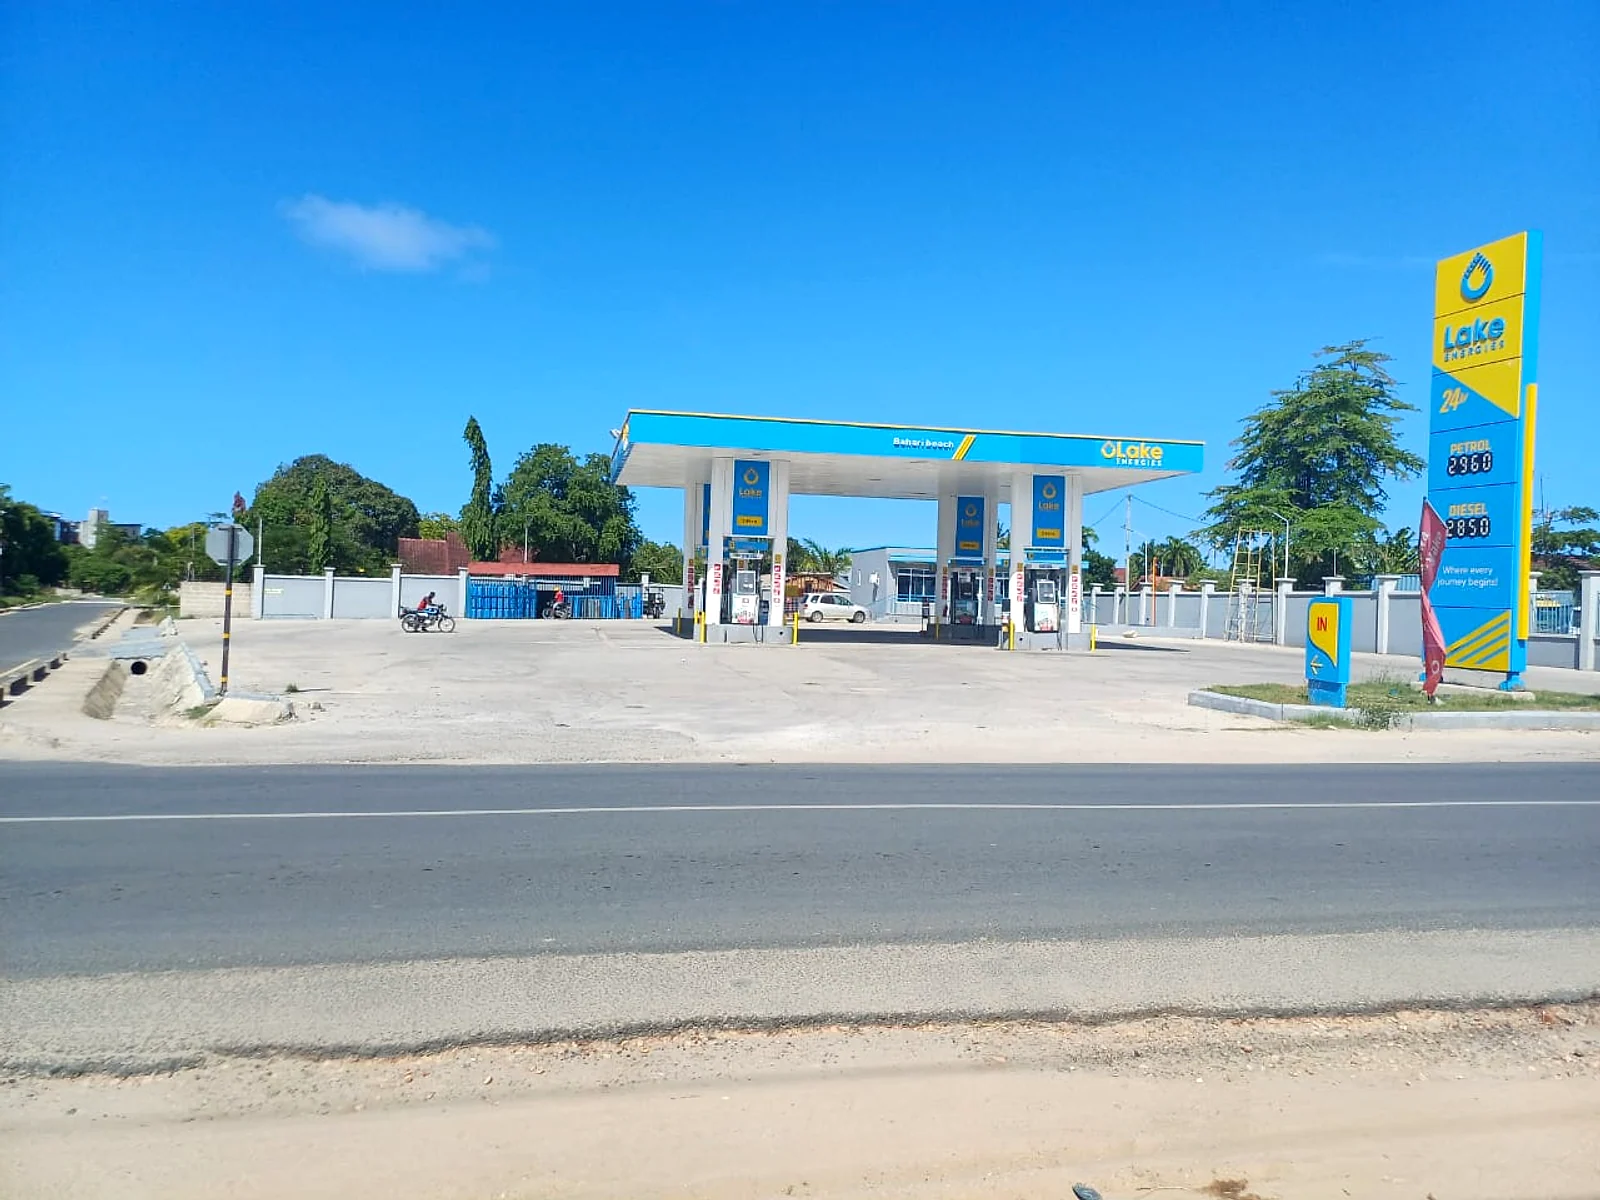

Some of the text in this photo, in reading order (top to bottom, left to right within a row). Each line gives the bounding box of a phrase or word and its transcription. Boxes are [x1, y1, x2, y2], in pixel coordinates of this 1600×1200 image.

[1443, 316, 1506, 349] Lake
[1443, 340, 1506, 362] ENERGIES
[893, 437, 954, 449] Bahari beach
[1116, 440, 1163, 460] Lake
[1450, 439, 1491, 454] PETROL
[1448, 452, 1492, 475] 2960
[1449, 502, 1488, 516] DIESEL
[1447, 518, 1489, 537] 2850
[1443, 565, 1493, 576] Where every
[1437, 578, 1467, 588] journey
[1317, 616, 1328, 631] IN
